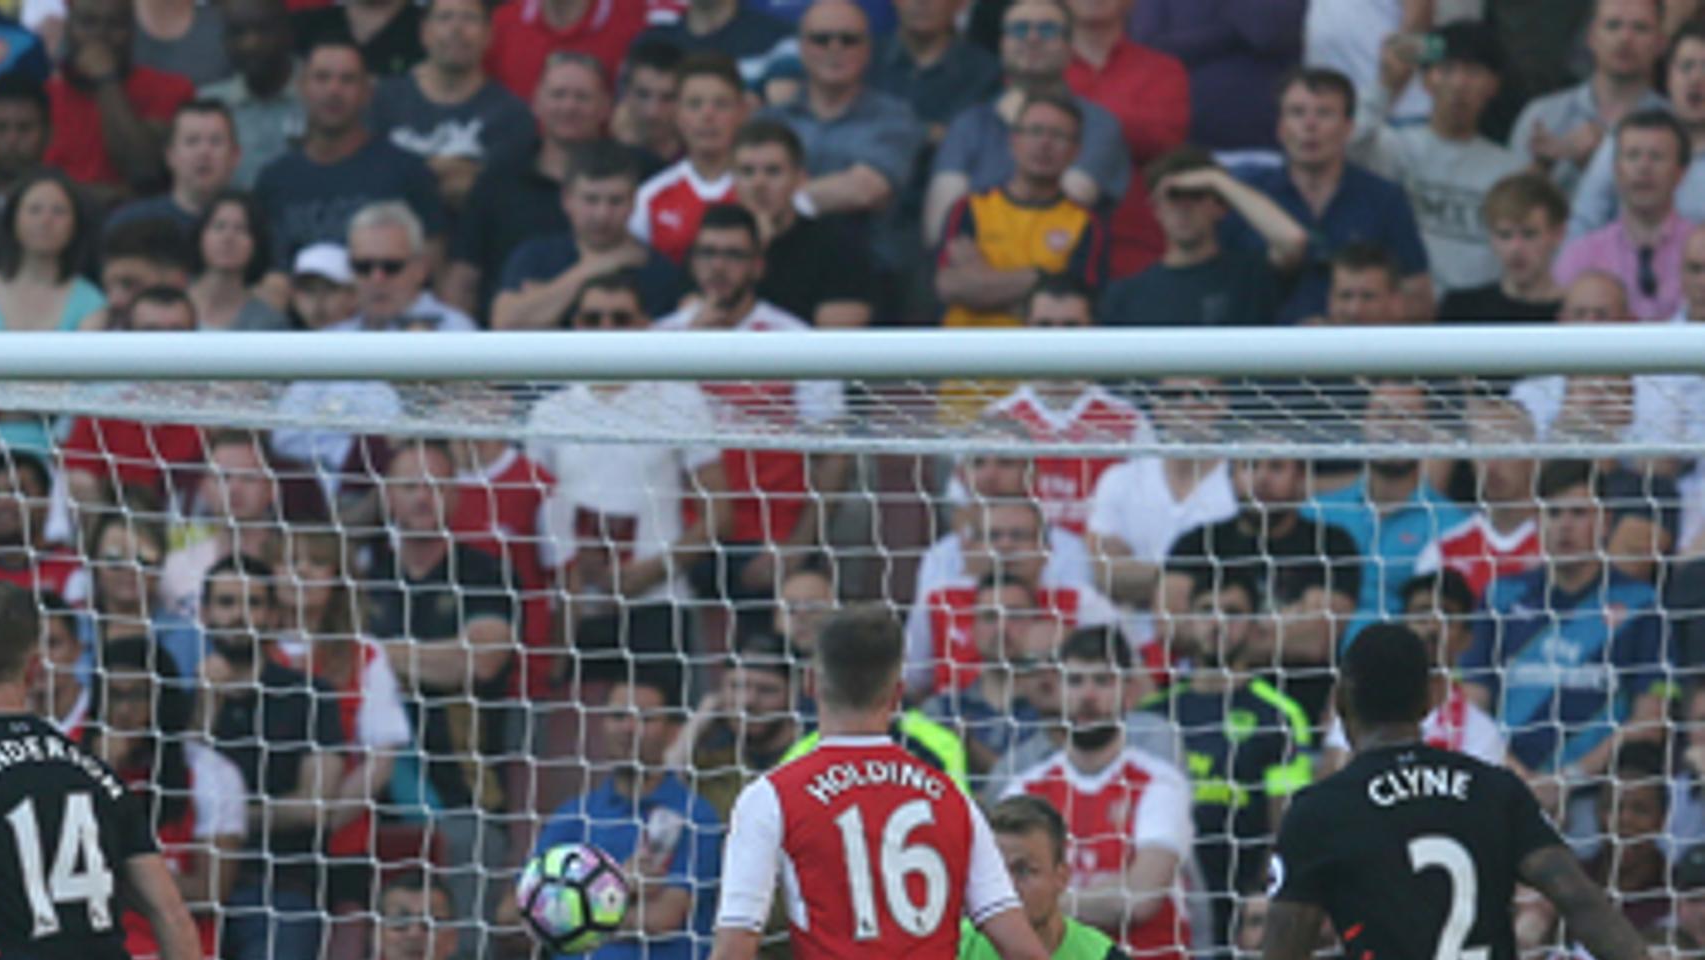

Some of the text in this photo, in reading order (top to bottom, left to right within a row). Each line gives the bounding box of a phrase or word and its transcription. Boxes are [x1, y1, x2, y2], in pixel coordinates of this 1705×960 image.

[806, 760, 947, 805] HOLDING
[1368, 765, 1472, 807] CLYNE
[5, 791, 114, 940] 14
[833, 798, 951, 940] 16
